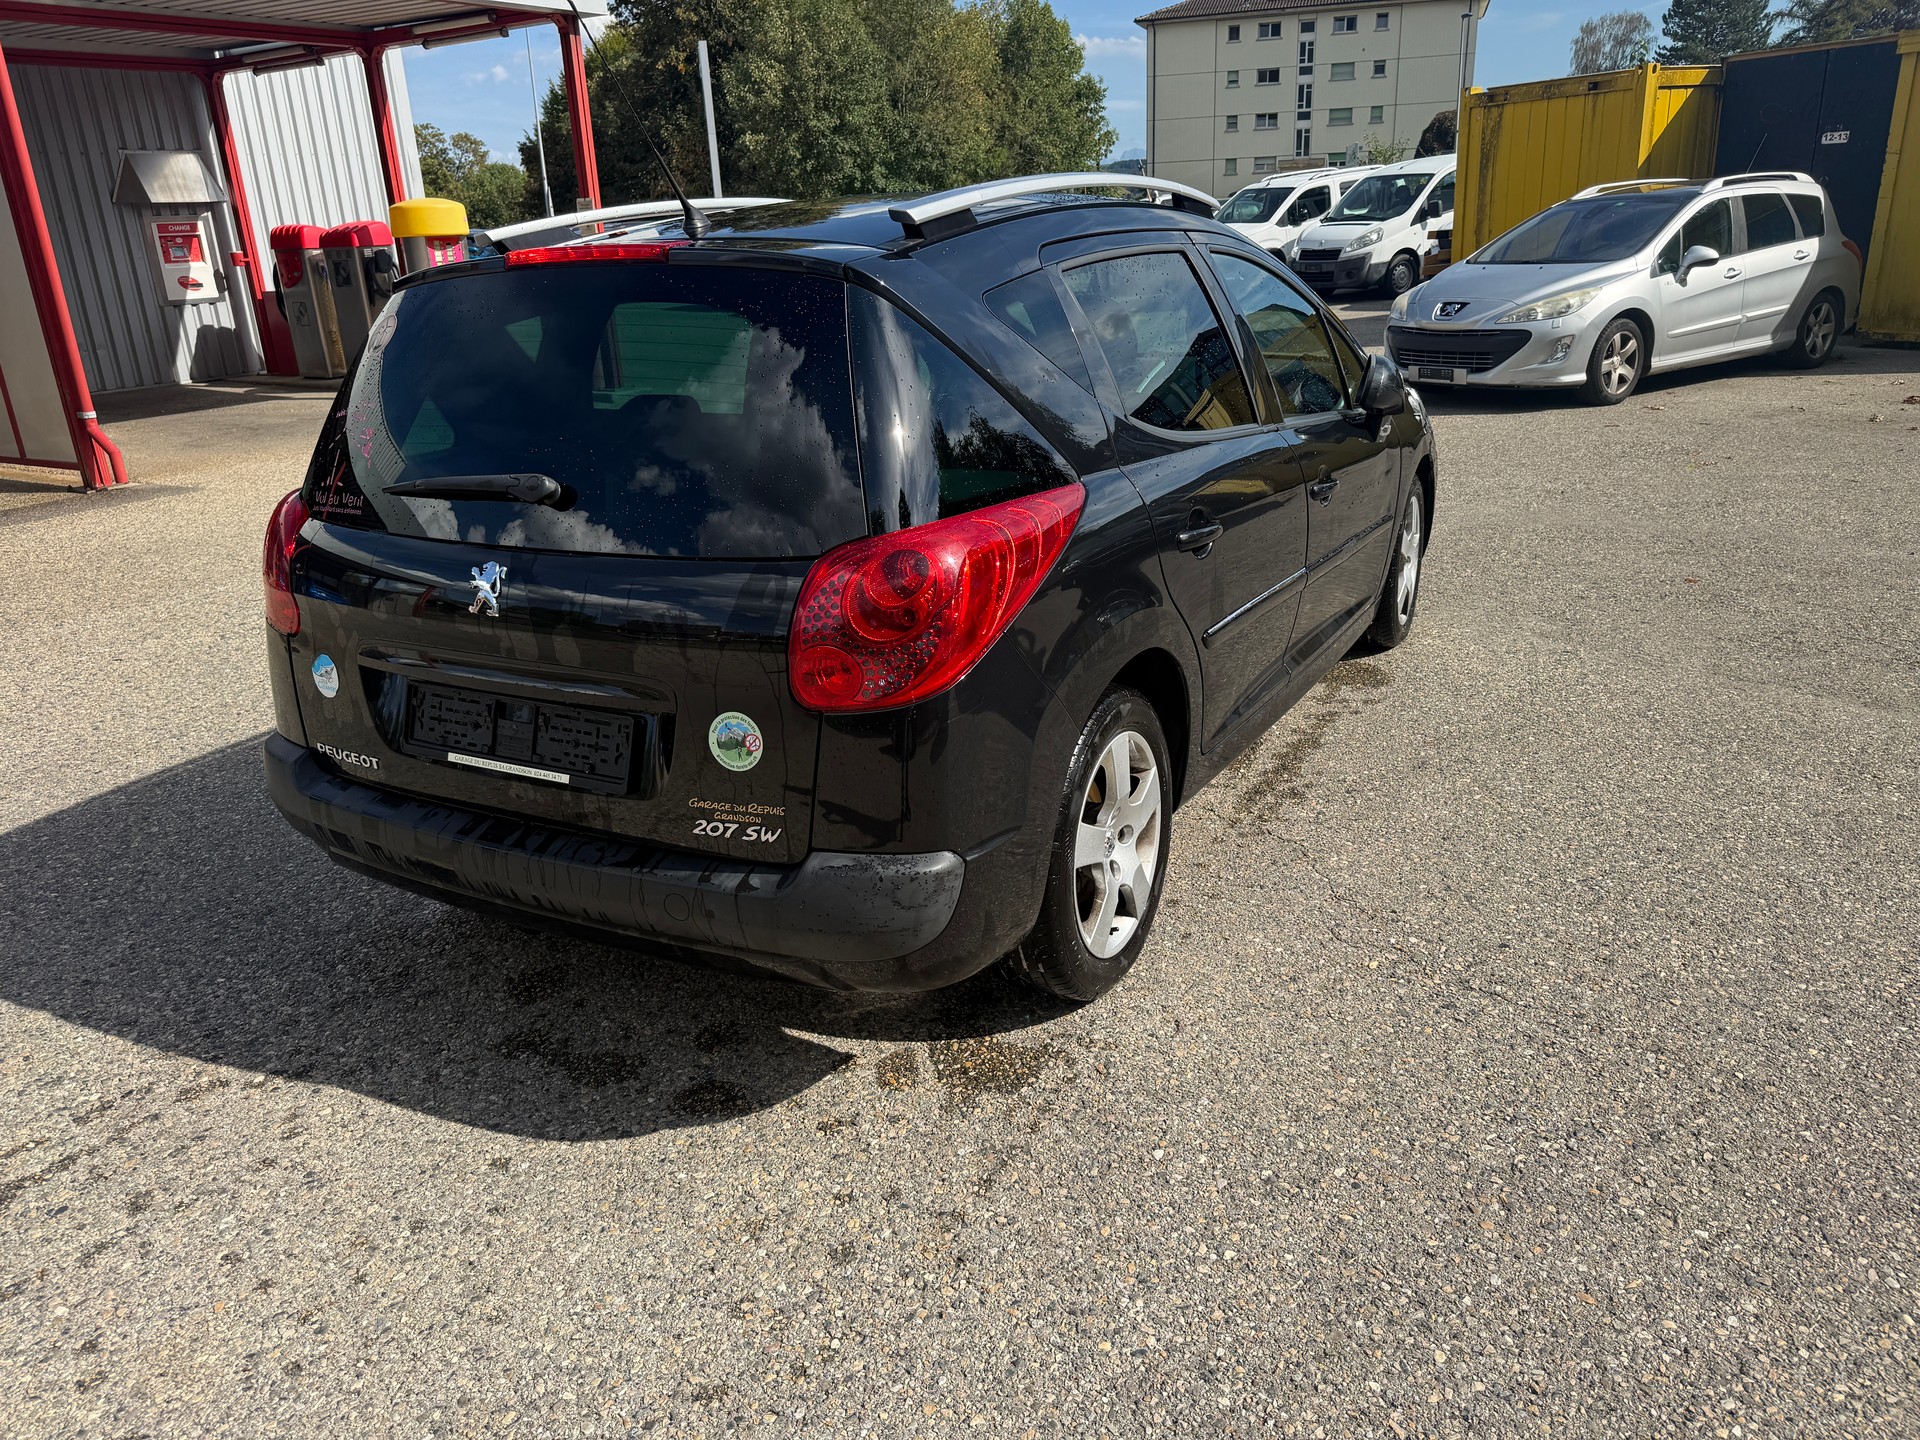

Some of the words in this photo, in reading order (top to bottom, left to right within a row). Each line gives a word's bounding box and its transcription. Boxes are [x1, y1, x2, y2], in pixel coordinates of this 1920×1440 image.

[1823, 132, 1849, 142] 12-13
[343, 493, 363, 506] Vent
[720, 714, 740, 724] protection
[316, 742, 380, 770] PEUGEOT
[454, 755, 474, 764] GARAGE
[688, 797, 731, 811] GARAGE
[732, 803, 746, 813] DU
[713, 811, 762, 824] GRANDSON
[693, 820, 739, 838] 207
[742, 826, 782, 843] SW
